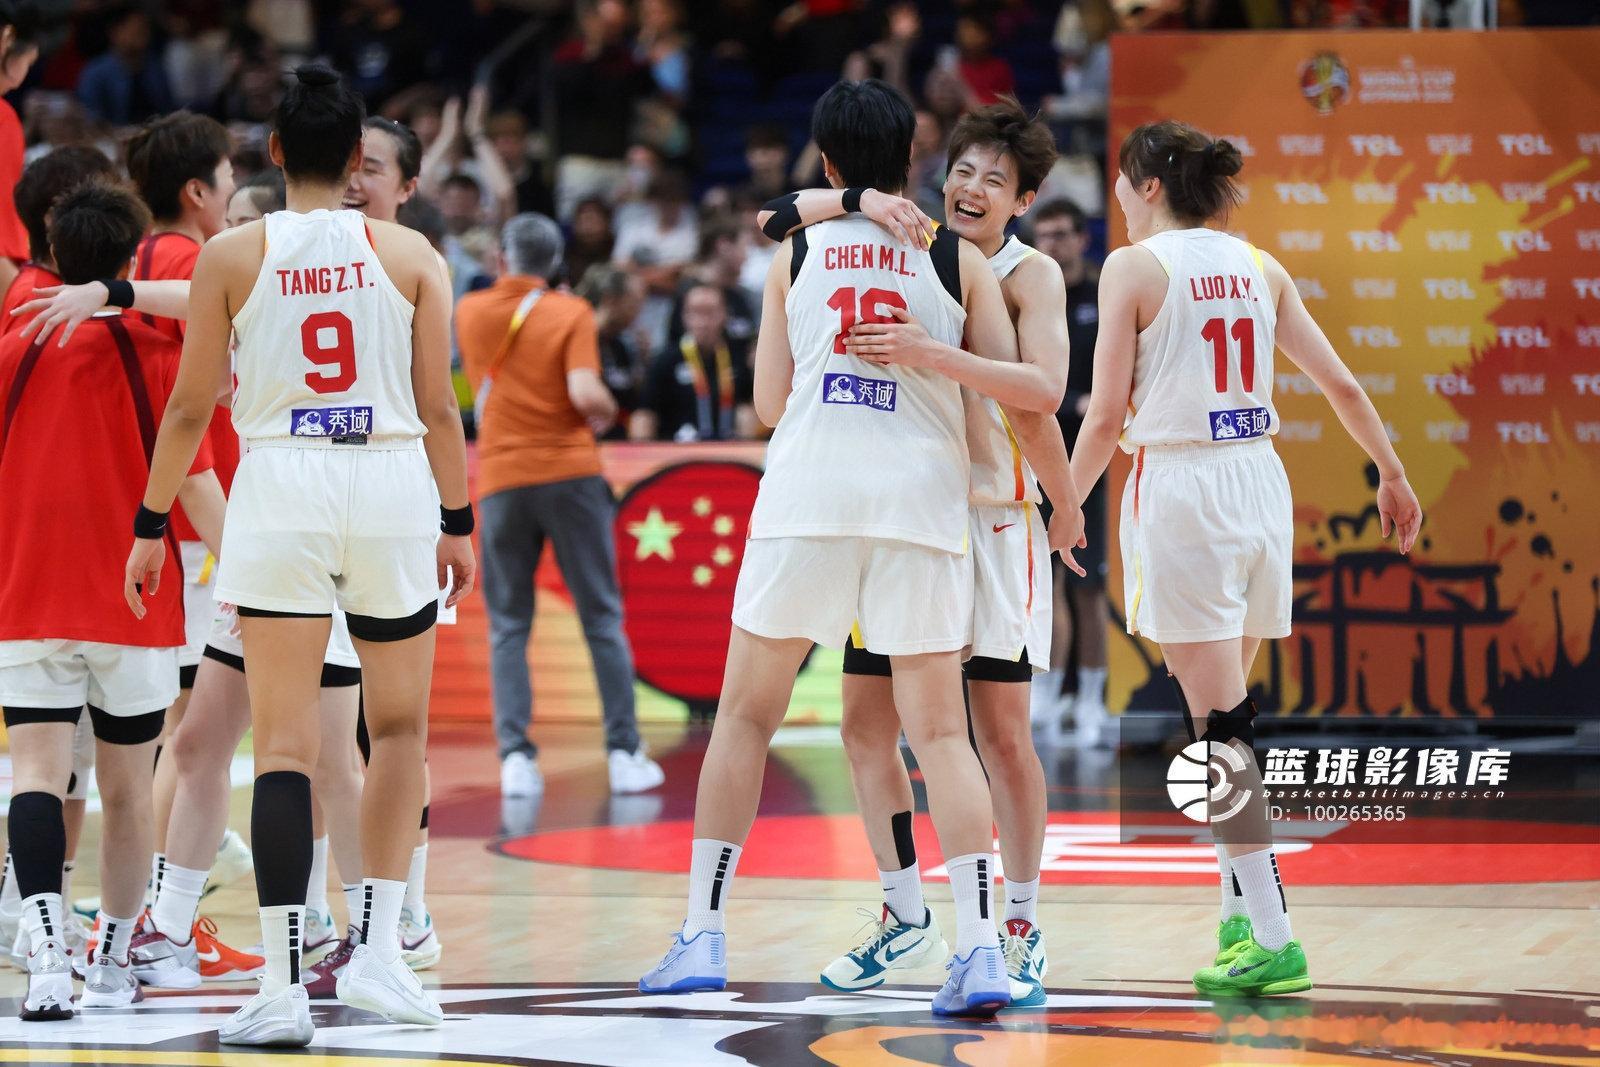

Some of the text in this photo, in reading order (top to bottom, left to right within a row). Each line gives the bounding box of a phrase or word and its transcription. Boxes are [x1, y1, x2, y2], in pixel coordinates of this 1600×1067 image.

[1349, 135, 1402, 156] TCL
[1498, 134, 1551, 156] TCL
[1275, 182, 1328, 204] TCL
[1423, 182, 1476, 204] TCL
[1348, 231, 1401, 252] TCL
[1498, 230, 1550, 252] TCL
[825, 244, 916, 277] CHEN M.L.
[276, 262, 375, 296] TANG Z.T.
[1190, 275, 1258, 301] LUO X.Y.
[1423, 278, 1476, 299] TCL
[1348, 326, 1401, 347] TCL
[1498, 326, 1549, 347] TCL
[301, 311, 357, 394] 9
[1201, 317, 1255, 393] 11
[858, 379, 894, 409] 秀域
[1423, 374, 1475, 395] TCL
[328, 410, 370, 436] 秀域
[1235, 410, 1268, 436] 秀域
[1497, 422, 1549, 443] TCL
